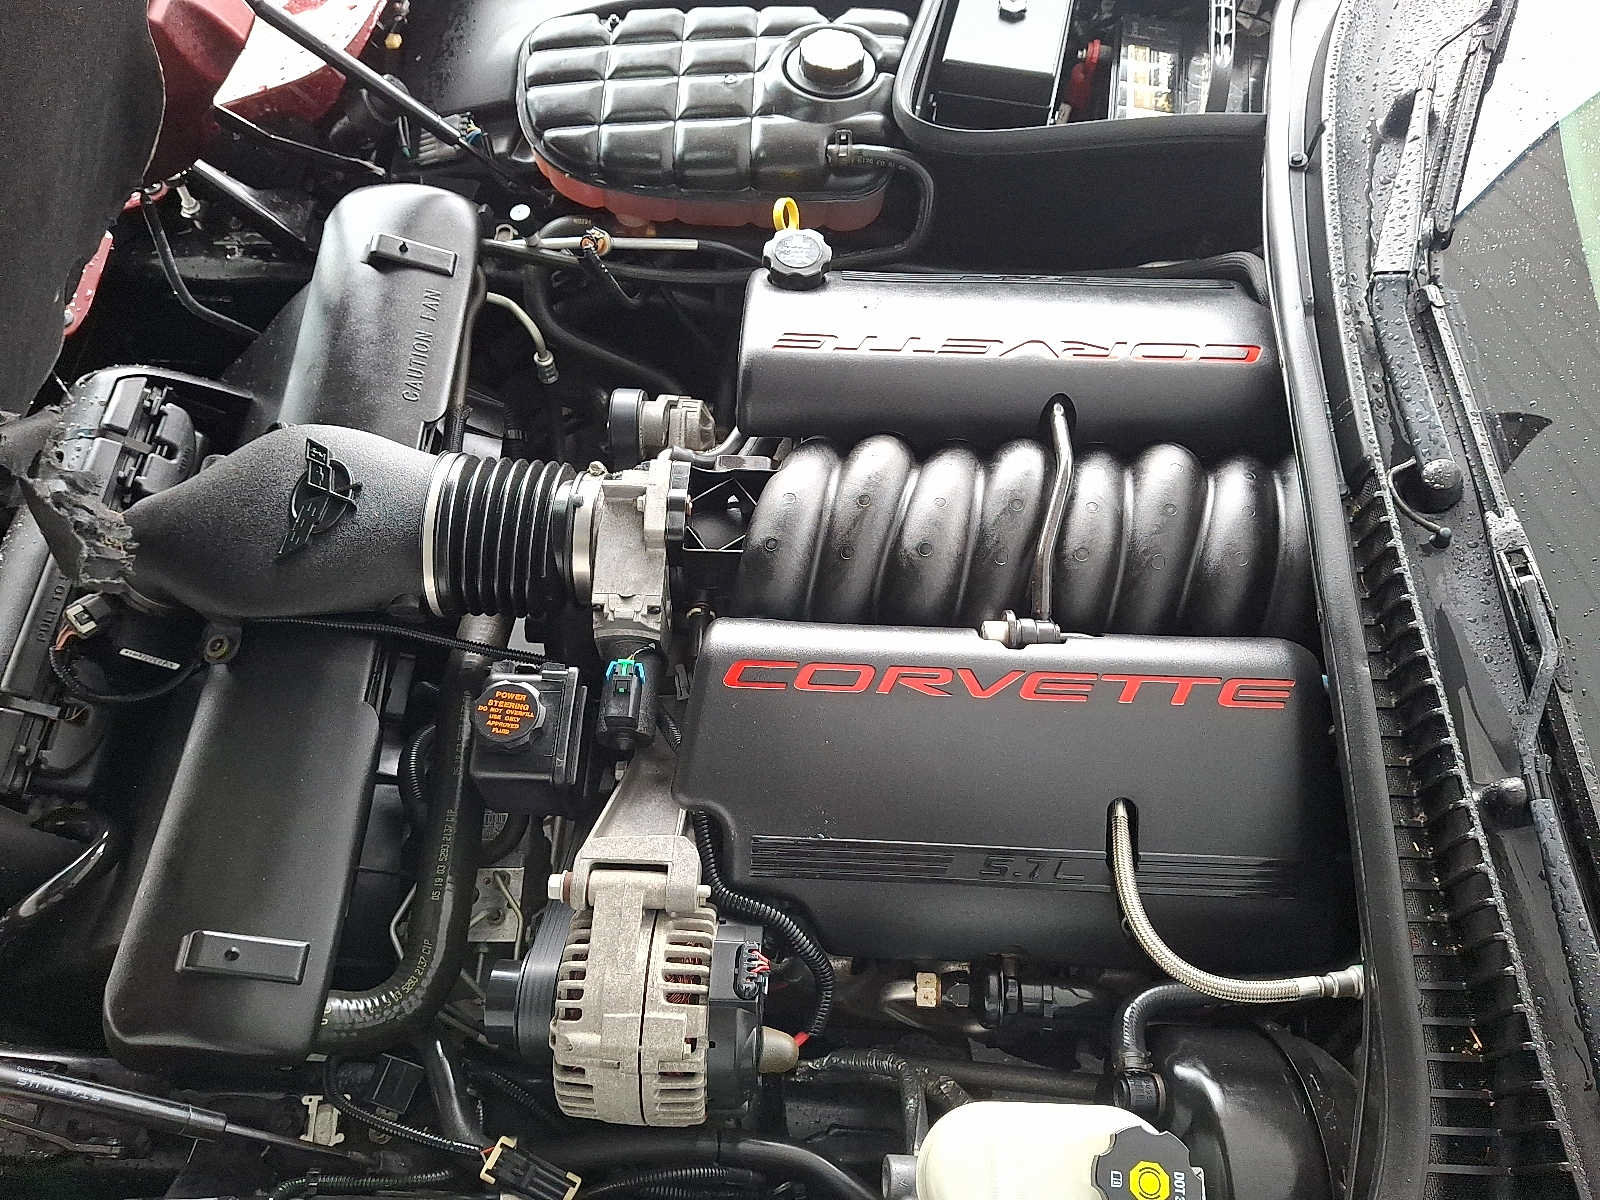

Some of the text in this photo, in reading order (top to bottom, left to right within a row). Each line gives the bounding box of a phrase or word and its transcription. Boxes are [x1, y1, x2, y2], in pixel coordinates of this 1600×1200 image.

[772, 332, 1263, 363] CORVETTE
[402, 329, 433, 402] CAUTION
[722, 659, 1296, 709] CORVETTE
[495, 690, 528, 701] POWER
[487, 699, 530, 711] STEERING
[505, 709, 535, 718] OVERFILL
[486, 720, 520, 729] APPROVED
[491, 727, 510, 735] FLUID
[979, 855, 1086, 881] 5.7L
[1173, 1171, 1186, 1196] DOT
